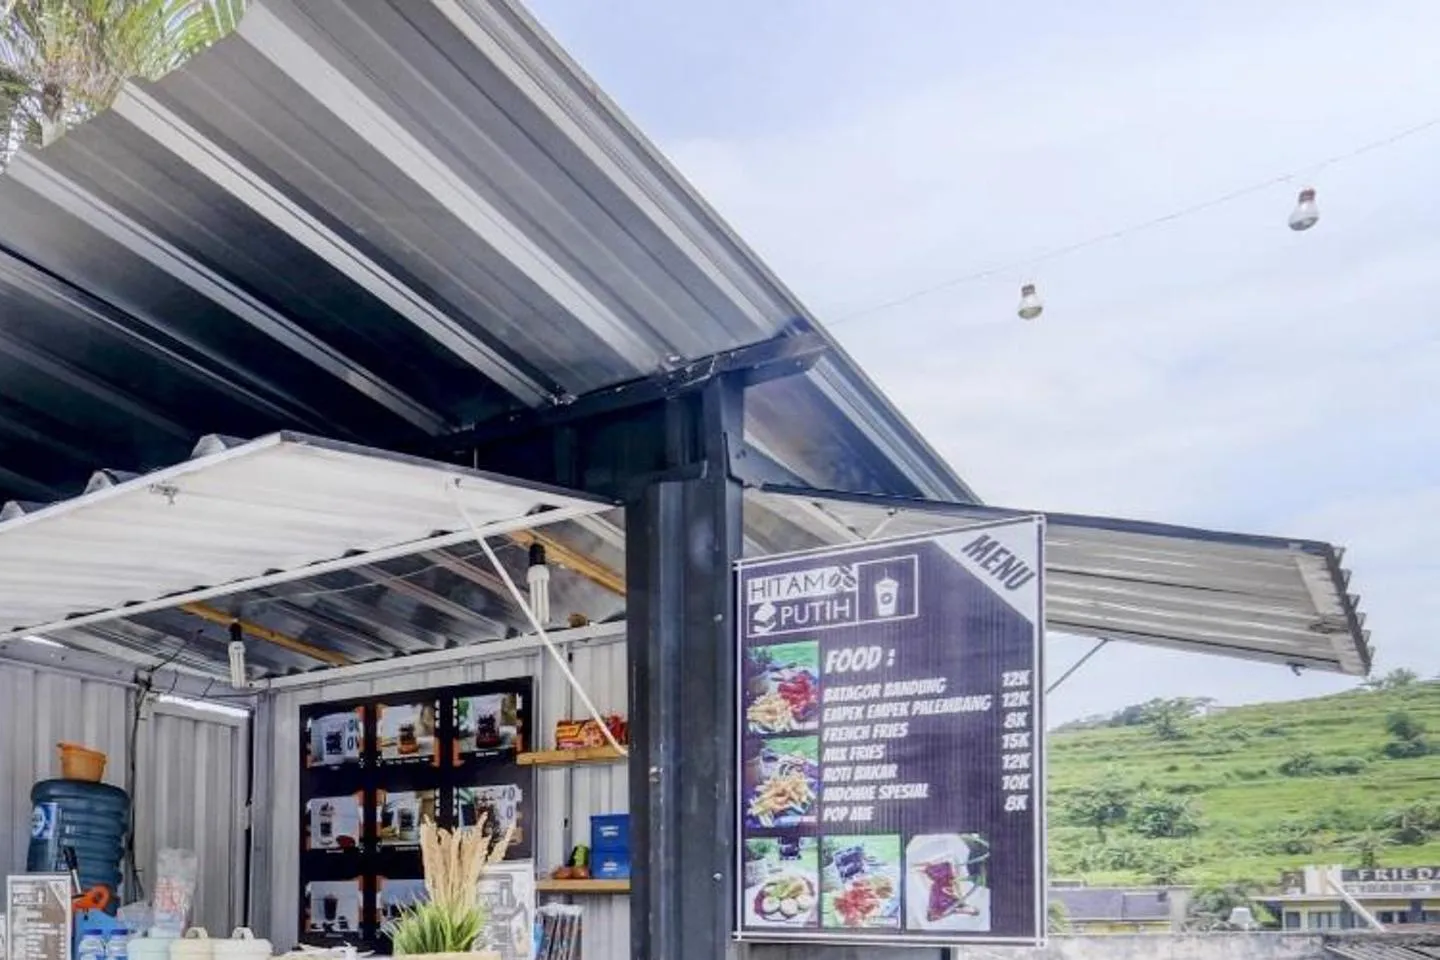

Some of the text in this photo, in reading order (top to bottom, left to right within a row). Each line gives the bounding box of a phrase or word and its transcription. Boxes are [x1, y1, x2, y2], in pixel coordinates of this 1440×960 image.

[961, 534, 1035, 591] MENU
[750, 573, 825, 601] HITAM
[781, 599, 850, 625] PUTIH
[825, 646, 882, 674] FOOD
[883, 677, 947, 698] BANDUNG
[1001, 670, 1030, 687] 12K
[867, 702, 910, 719] EMPEK
[912, 694, 992, 716] PALEMBANG
[1001, 691, 1030, 707] 12K
[823, 711, 1027, 743] FRENCH FRIES 8K
[849, 744, 886, 760] FRIES
[1002, 732, 1030, 749] 15K
[823, 753, 1031, 782] ROTI BAKAR 12K
[878, 783, 929, 799] SPESIAL
[1002, 774, 1031, 790] 10K
[823, 806, 849, 822] POP
[849, 806, 875, 821] MIE
[1004, 795, 1028, 811] 8K
